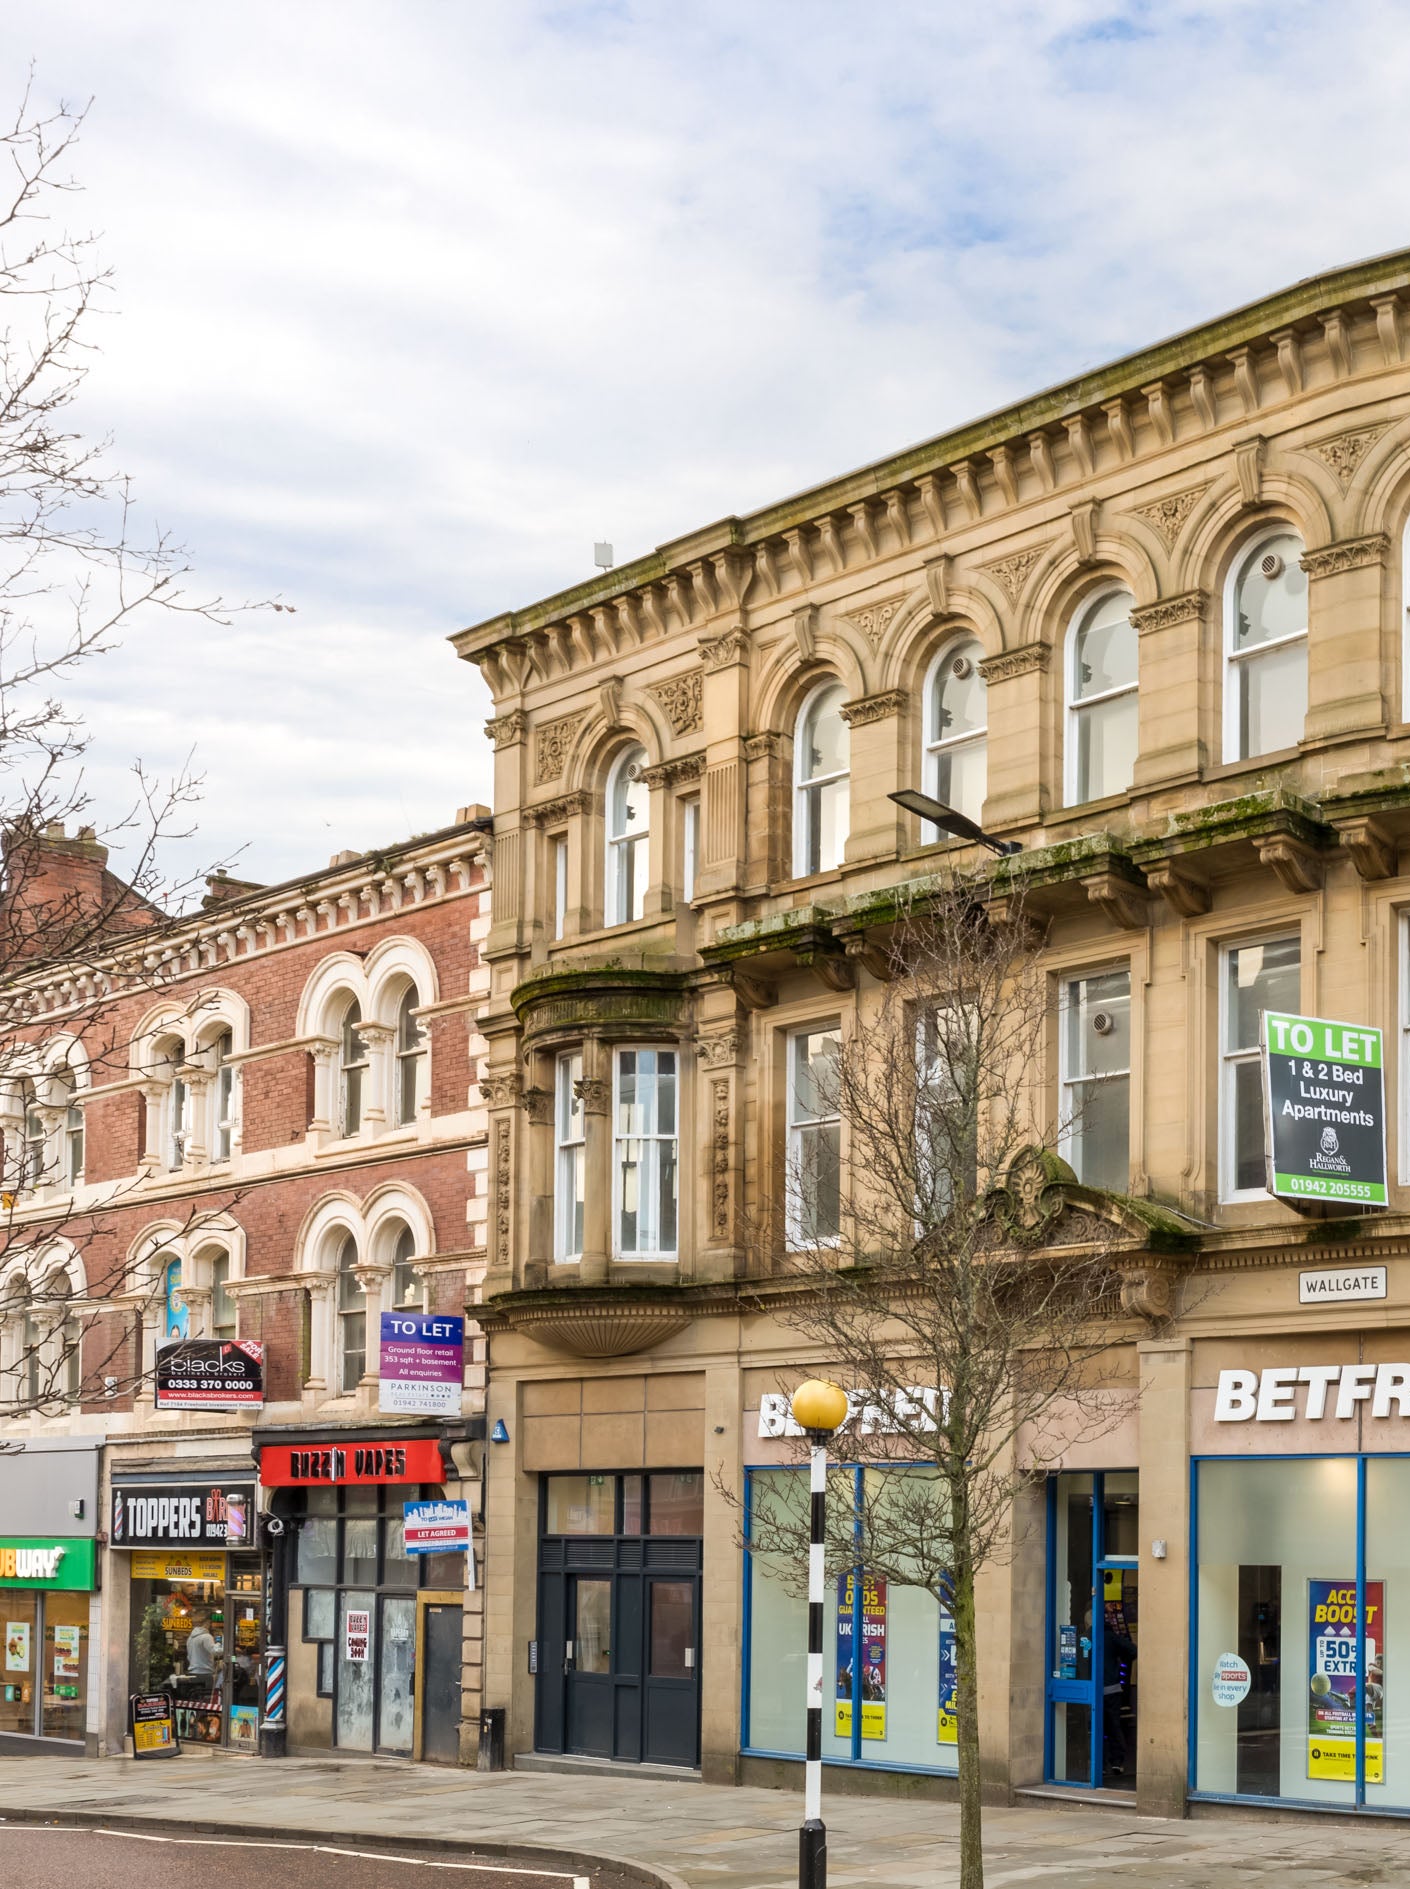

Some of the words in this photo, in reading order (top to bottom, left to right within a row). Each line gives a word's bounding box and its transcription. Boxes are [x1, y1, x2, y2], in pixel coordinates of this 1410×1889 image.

[1272, 1020, 1314, 1054] TO
[1325, 1029, 1377, 1063] LET
[1288, 1060, 1296, 1076] 1
[1303, 1062, 1315, 1078] &
[1318, 1064, 1328, 1080] 2
[1332, 1067, 1363, 1085] Bed
[1300, 1082, 1353, 1106] Luxury
[1282, 1100, 1374, 1127] Apartments
[1291, 1178, 1327, 1194] 01942
[1330, 1182, 1371, 1198] 205555
[1306, 1276, 1379, 1293] WALLGATE
[391, 1321, 416, 1335] TO
[422, 1323, 453, 1337] LET
[240, 1344, 260, 1359] SALE
[247, 1340, 262, 1354] FOR
[388, 1346, 415, 1355] Ground
[435, 1349, 454, 1357] retail
[400, 1357, 413, 1365] sqft
[422, 1358, 457, 1366] basement
[410, 1369, 442, 1377] enquiries
[168, 1380, 197, 1389] 0333
[200, 1380, 222, 1389] 370
[225, 1381, 253, 1390] 0000
[391, 1383, 452, 1393] PARKINSON
[419, 1400, 446, 1408] 741800
[355, 1448, 407, 1478] VAPES
[127, 1498, 201, 1538] TOPPERS
[431, 1530, 456, 1538] AGREED
[165, 1566, 192, 1576] SUNBEDS
[846, 1591, 878, 1605] ODS
[1327, 1590, 1357, 1604] ACC
[162, 1618, 193, 1629] SUNBEDS
[839, 1623, 852, 1635] UK
[863, 1624, 885, 1636] RISH
[1325, 1660, 1357, 1673] EXTR
[1222, 1672, 1247, 1680] sports
[1218, 1693, 1235, 1701] shop
